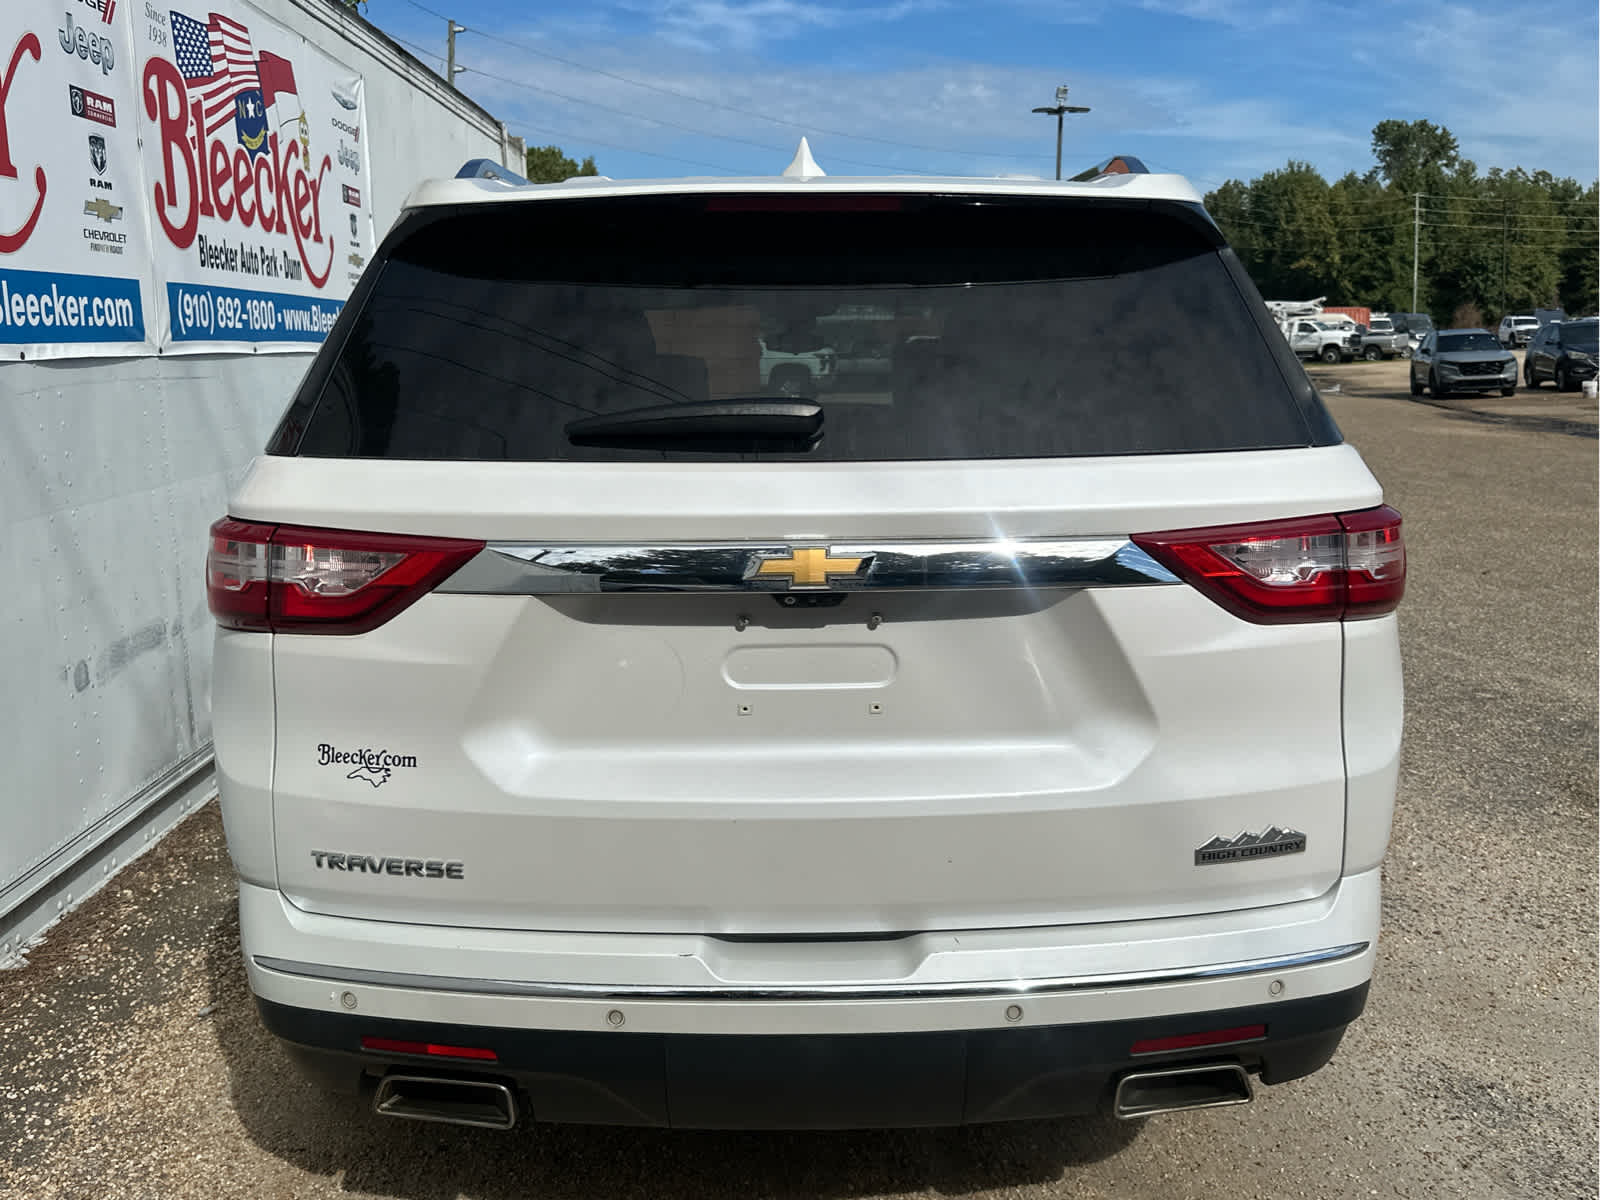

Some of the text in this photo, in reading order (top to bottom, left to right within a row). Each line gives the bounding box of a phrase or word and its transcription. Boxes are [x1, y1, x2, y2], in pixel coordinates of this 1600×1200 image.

[145, 2, 166, 26] Since
[59, 12, 115, 76] Jeep
[148, 25, 167, 47] 1938
[86, 96, 113, 113] RAM
[89, 177, 113, 190] RAM
[143, 57, 334, 289] Bleecker
[83, 228, 127, 243] CHEVROLET
[198, 233, 238, 272] Bleecker
[240, 241, 259, 275] Auto
[260, 246, 279, 278] Park
[283, 250, 303, 280] Dunn
[0, 279, 134, 327] leecker.com
[178, 288, 215, 336] (910)
[216, 296, 277, 331] 892-1800
[1201, 839, 1303, 862] HIGH COUNTRY
[310, 850, 465, 880] TRAVERSE
